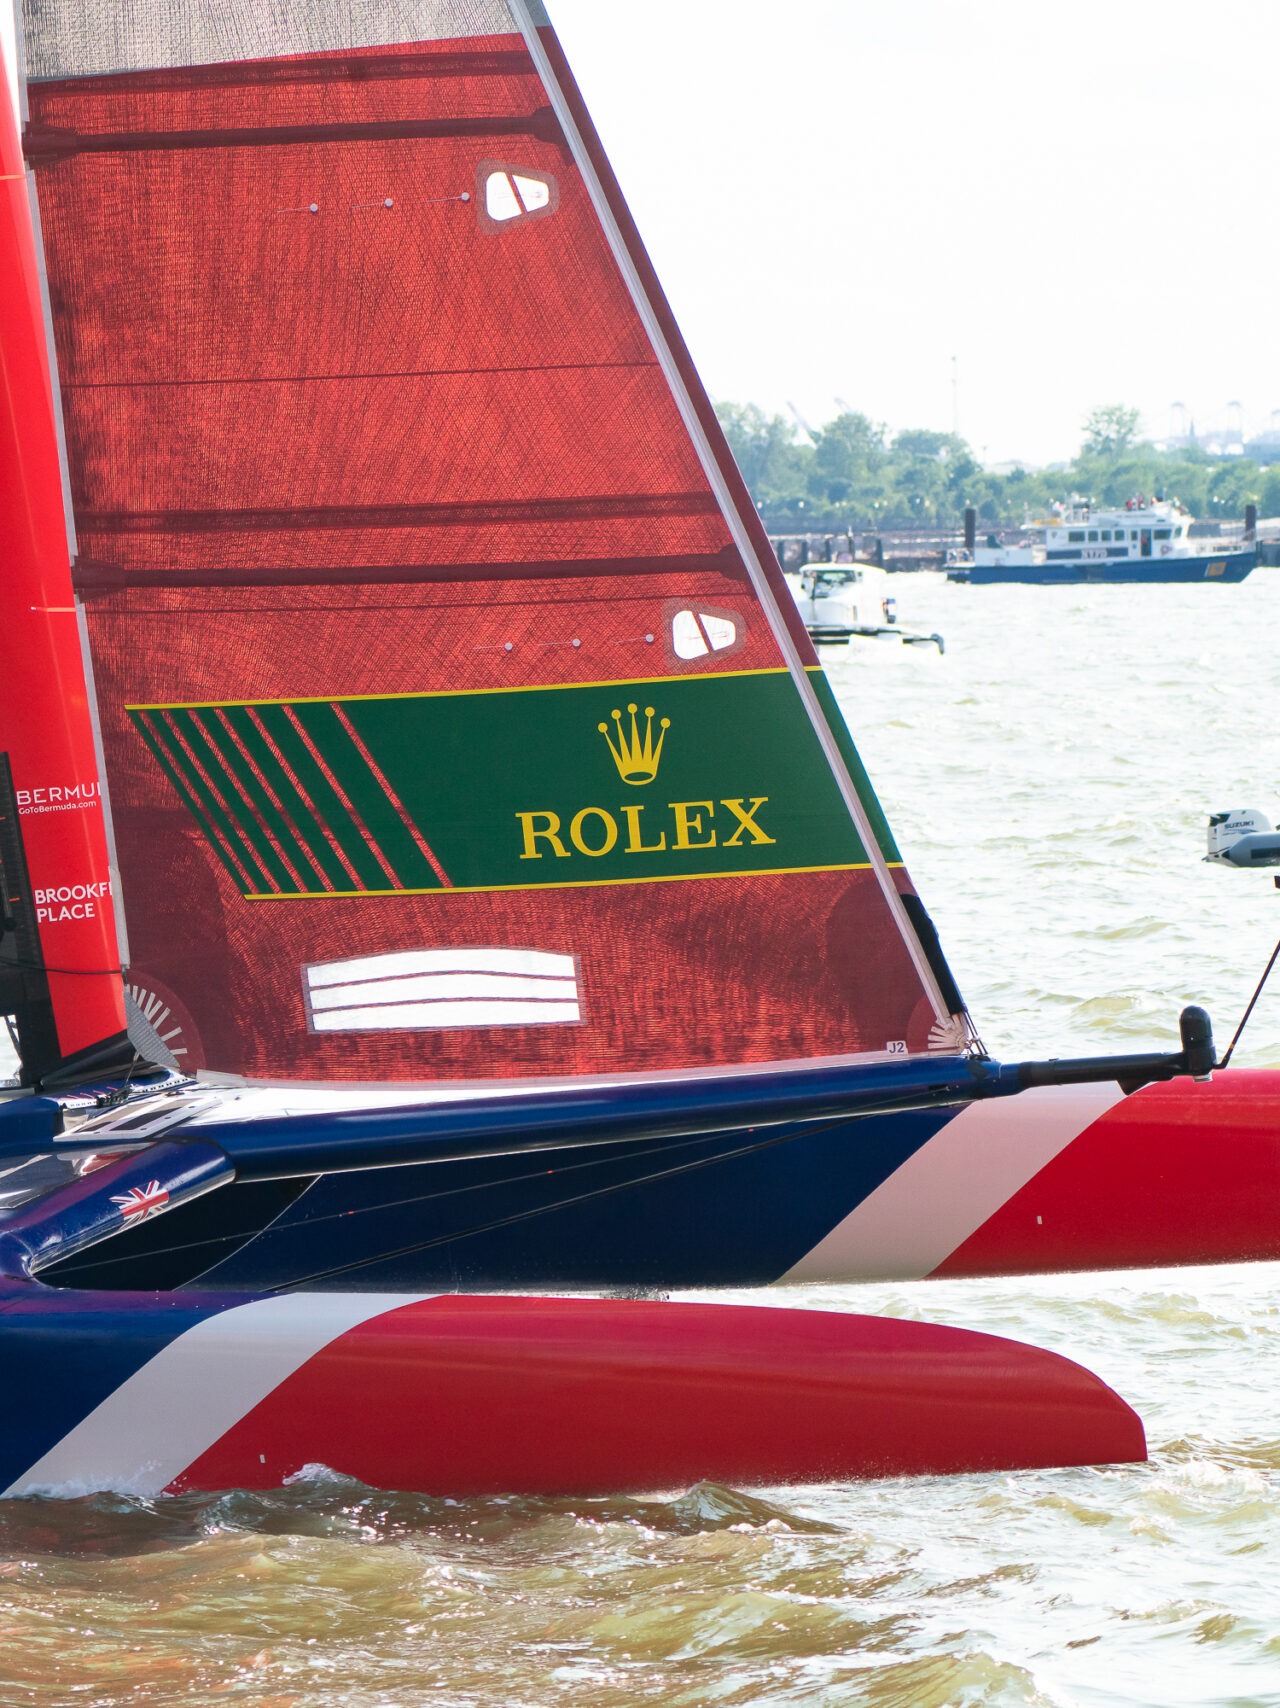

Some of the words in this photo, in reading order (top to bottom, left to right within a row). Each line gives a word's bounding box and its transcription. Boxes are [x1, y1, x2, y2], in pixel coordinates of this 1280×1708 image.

[16, 781, 101, 806] BERMU
[18, 800, 97, 815] GoToBermuda.com
[515, 797, 777, 859] ROLEX
[36, 903, 95, 924] PLACE
[889, 1041, 905, 1054] J2
